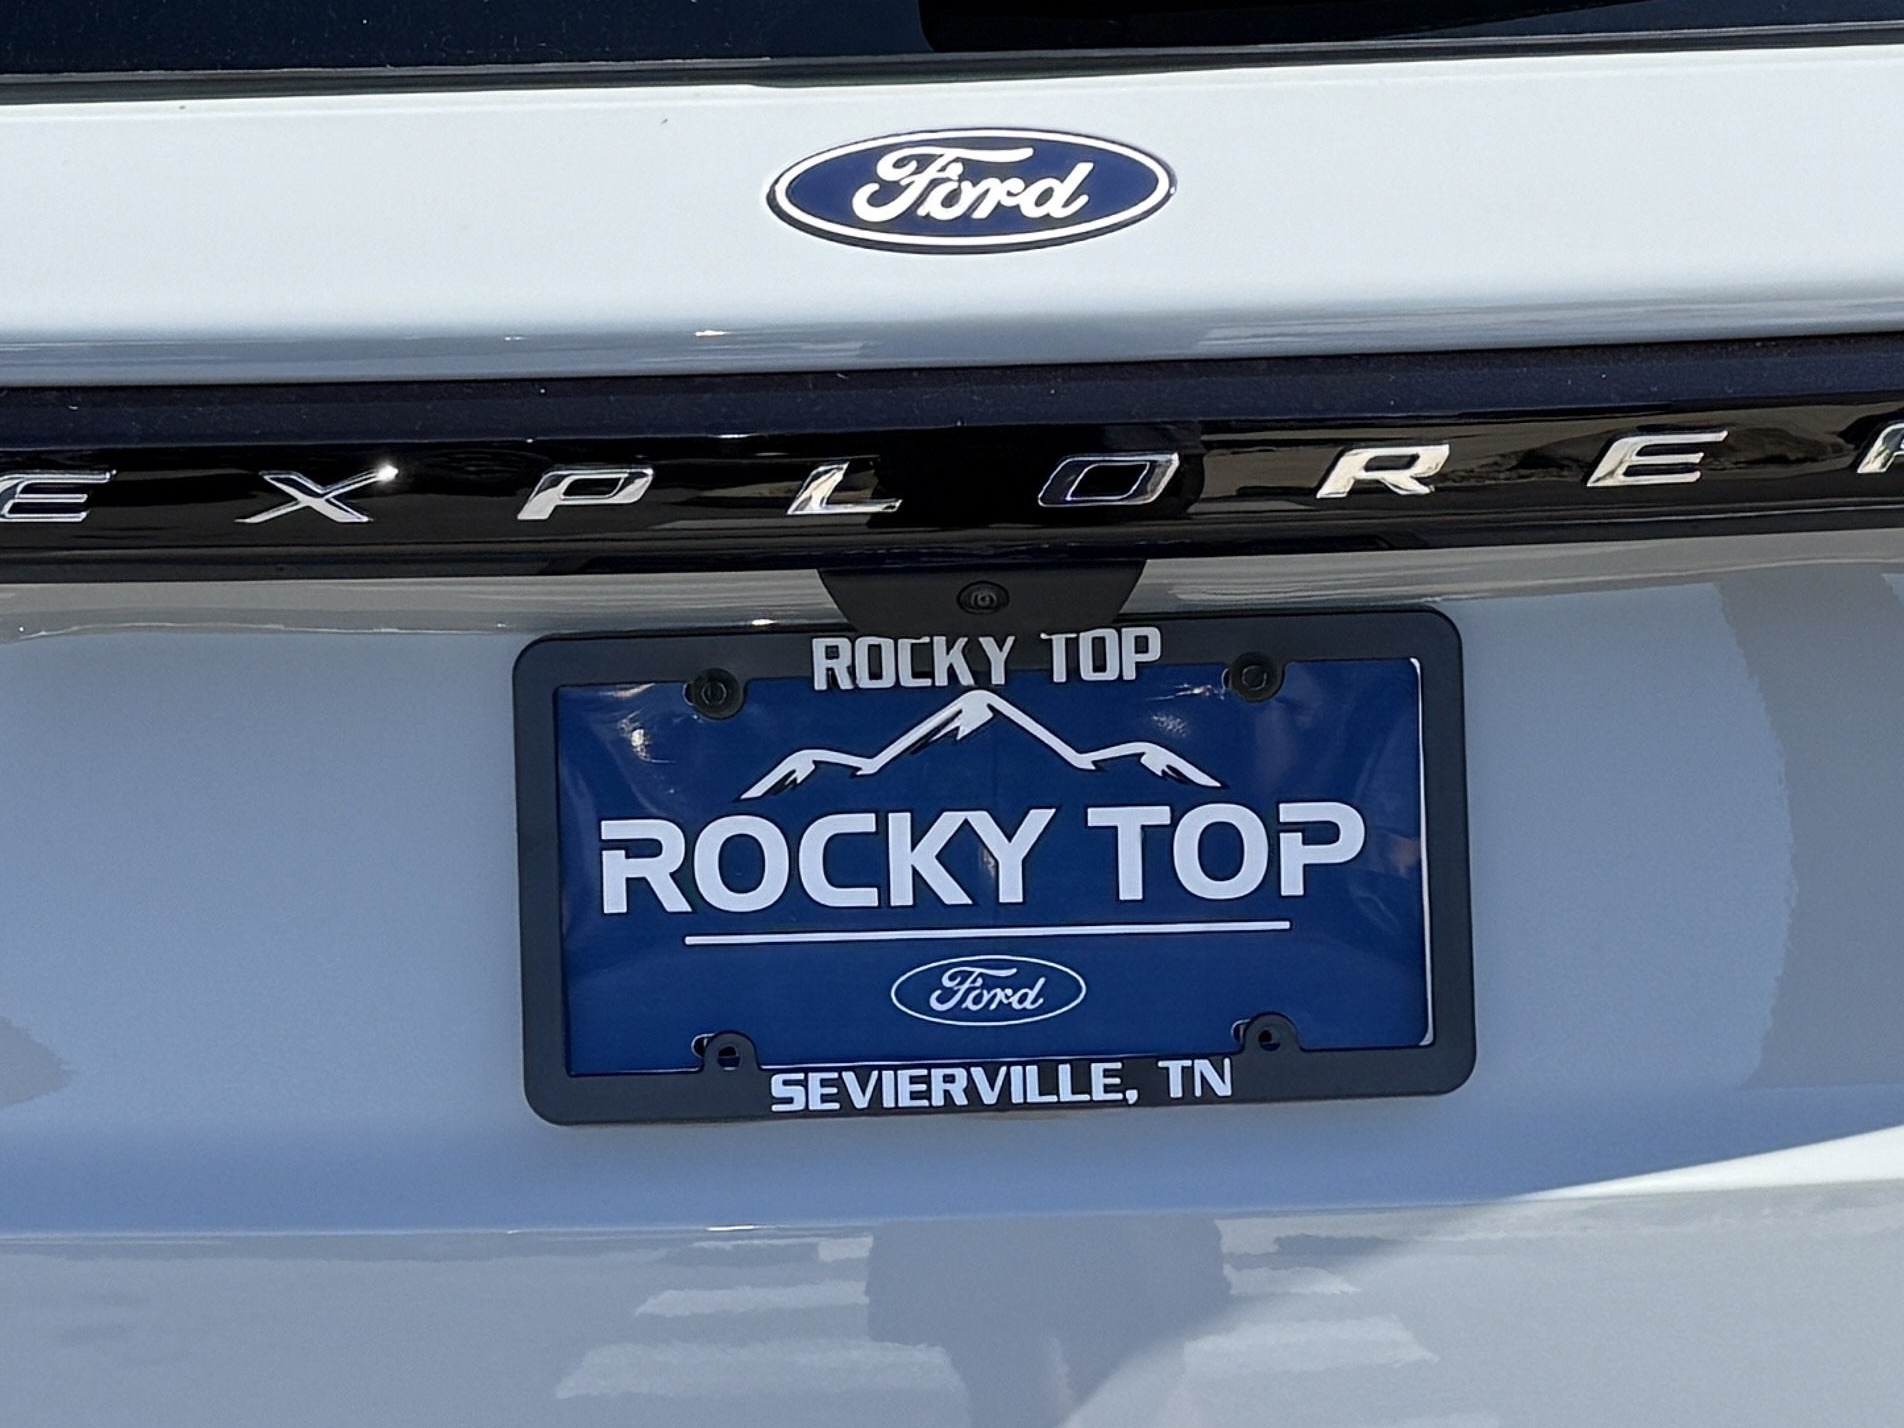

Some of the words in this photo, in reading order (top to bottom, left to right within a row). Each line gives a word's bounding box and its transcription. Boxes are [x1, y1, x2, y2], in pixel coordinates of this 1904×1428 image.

[851, 145, 1095, 223] Ford
[811, 635, 1016, 691] ROCKY
[1039, 626, 1162, 683] TOP
[599, 807, 1057, 914] ROCKY
[1086, 801, 1367, 901] TOP
[929, 966, 1045, 1012] Ford
[770, 1061, 1139, 1113] SEVIERVILLE,
[1156, 1057, 1232, 1099] TN
